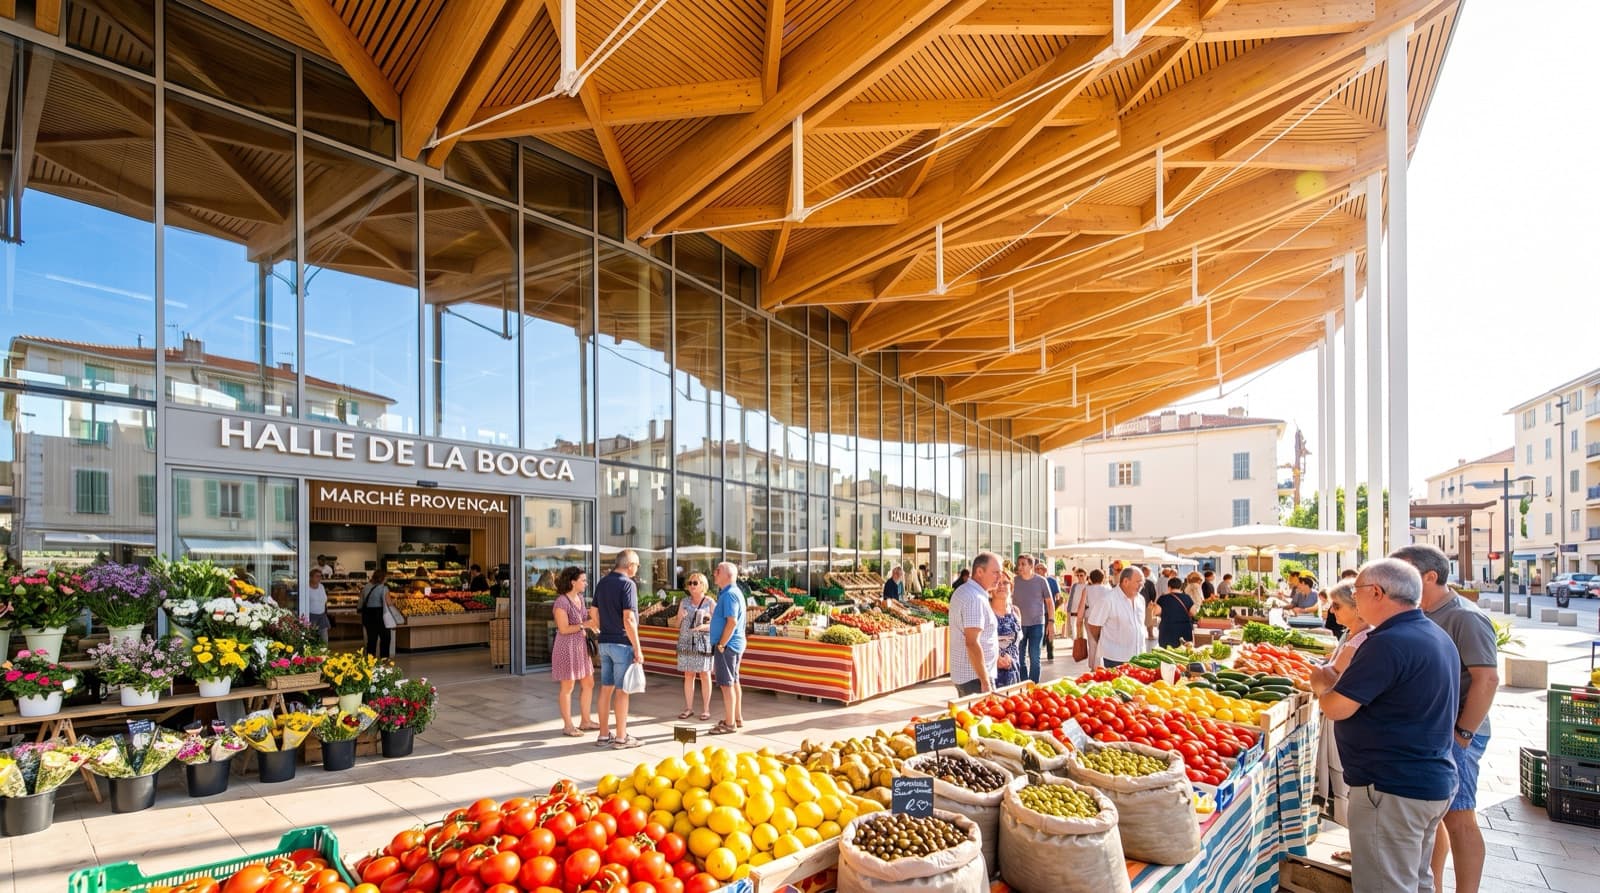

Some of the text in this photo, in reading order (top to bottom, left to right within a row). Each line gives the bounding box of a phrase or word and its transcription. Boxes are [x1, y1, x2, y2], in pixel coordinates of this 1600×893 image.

[220, 417, 575, 481] HALLE DE LA BOCCA
[320, 487, 508, 514] MARCHÉ PROVENÇAL
[889, 510, 950, 528] HALLE DE LA BOCCA
